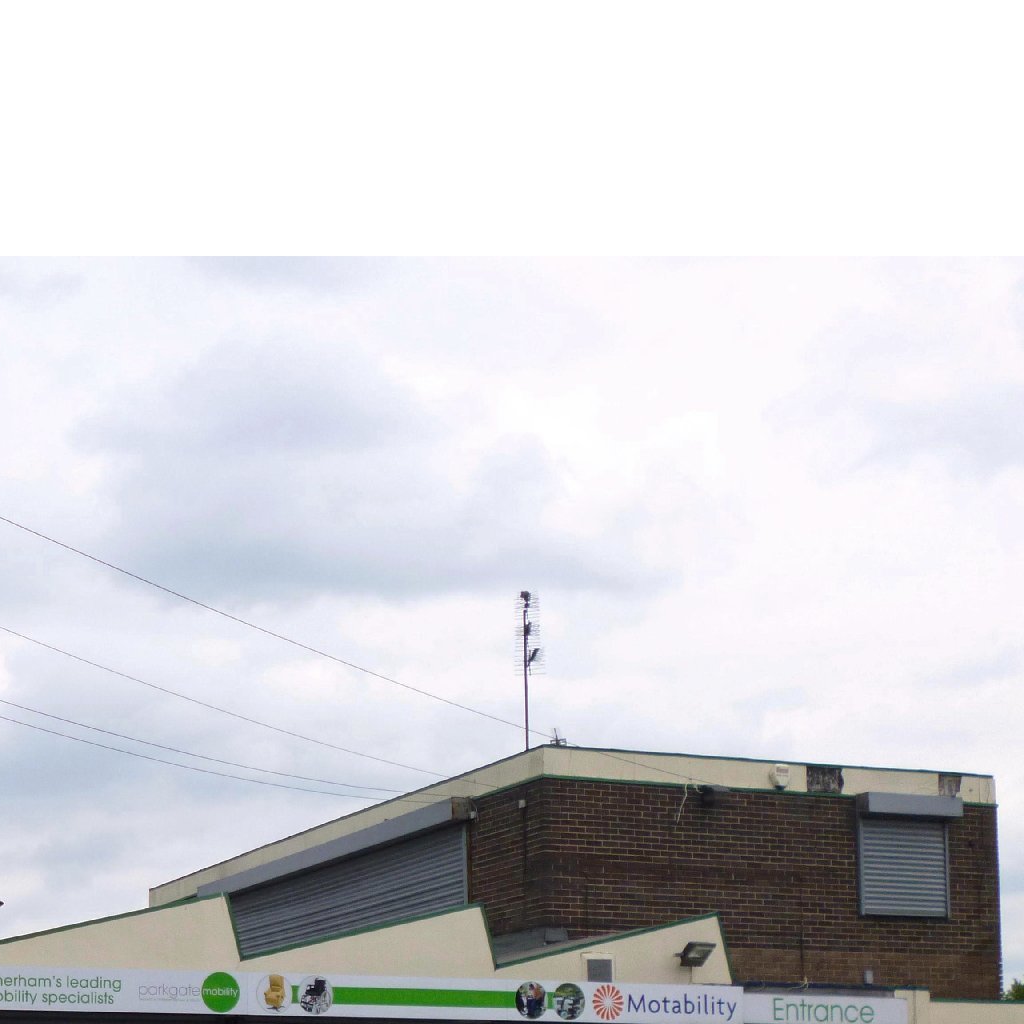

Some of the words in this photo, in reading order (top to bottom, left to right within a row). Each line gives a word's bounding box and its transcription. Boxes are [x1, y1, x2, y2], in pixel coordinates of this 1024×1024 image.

[66, 975, 122, 992] leading
[138, 983, 201, 1000] parkgate
[202, 987, 239, 998] mobility
[42, 991, 114, 1005] specialists
[627, 993, 737, 1021] Motability
[773, 997, 875, 1024] Entrance
